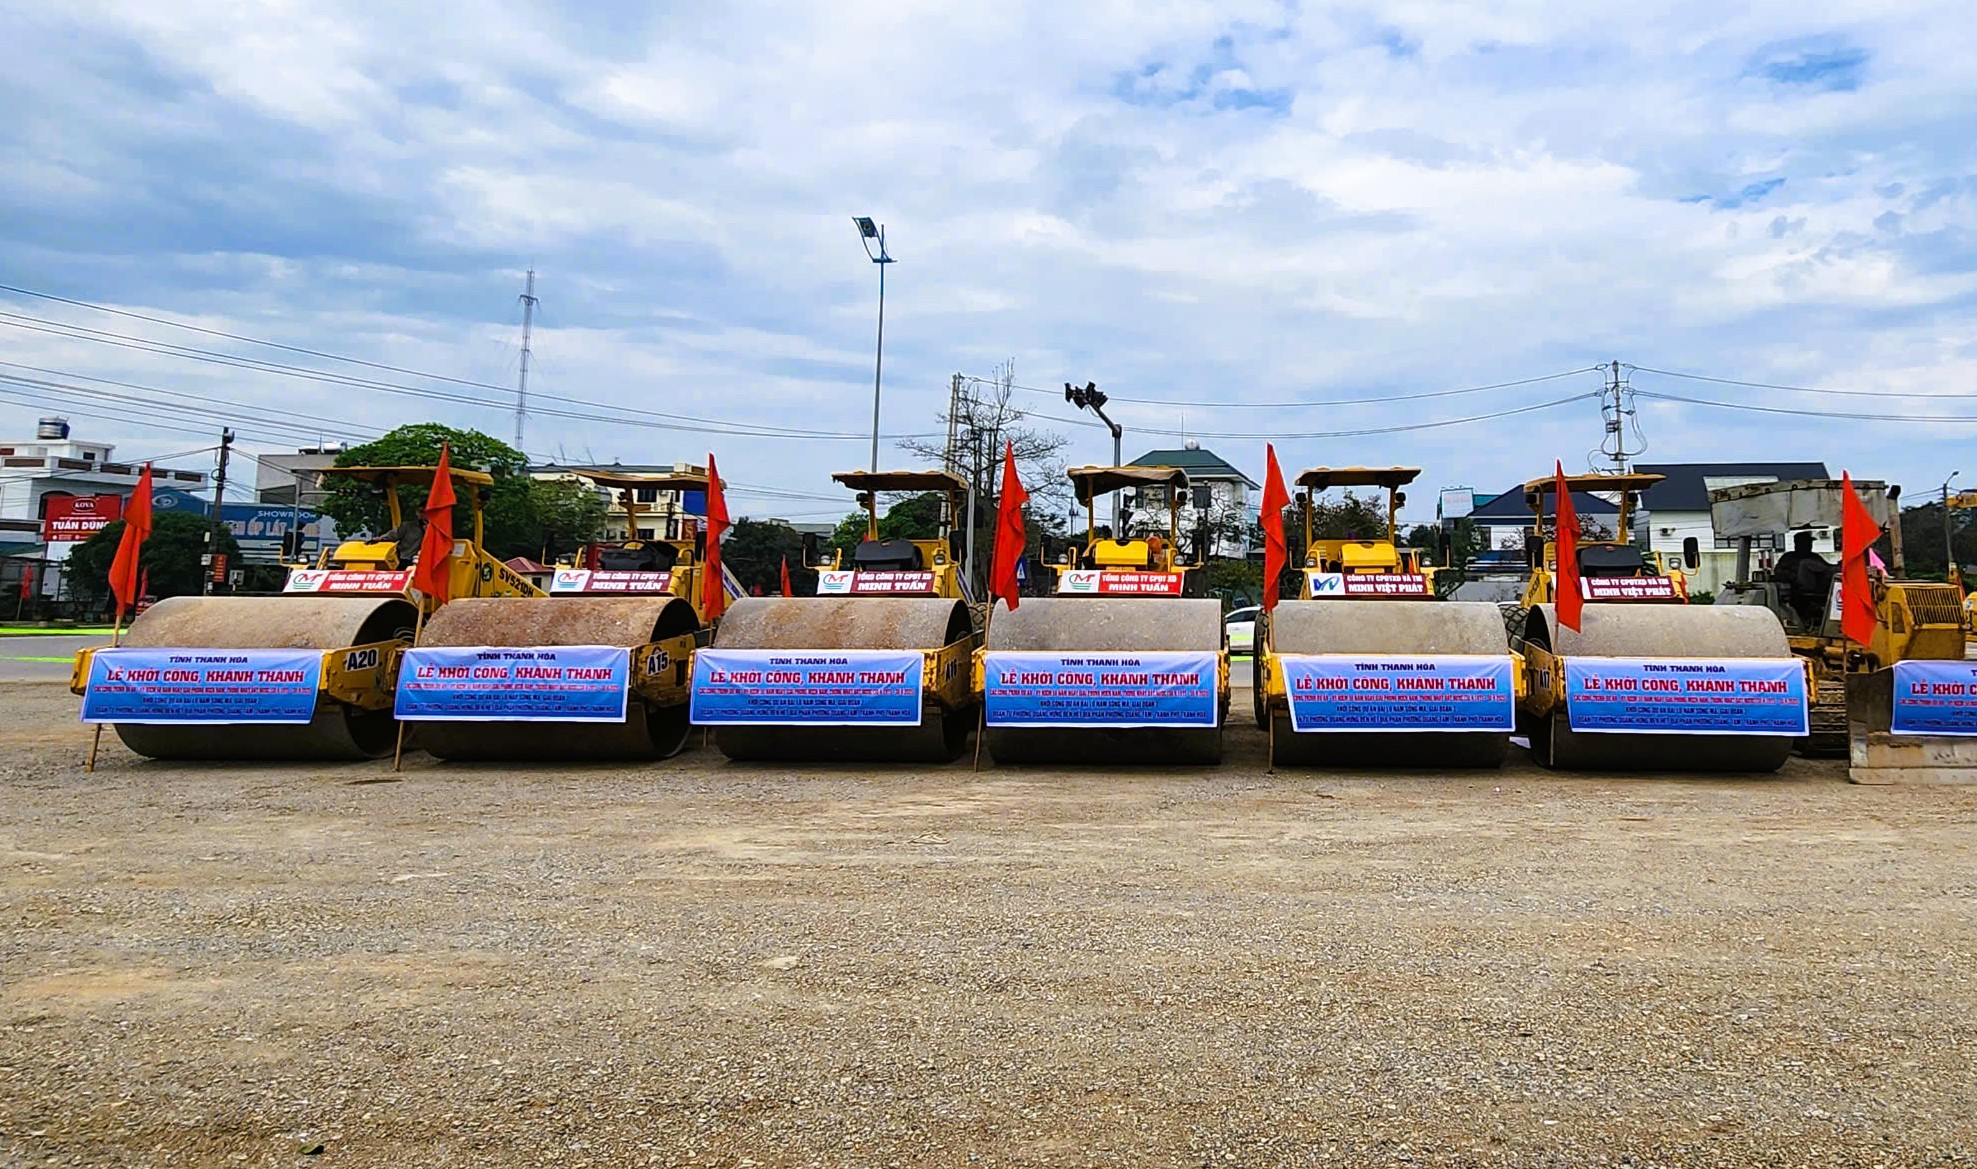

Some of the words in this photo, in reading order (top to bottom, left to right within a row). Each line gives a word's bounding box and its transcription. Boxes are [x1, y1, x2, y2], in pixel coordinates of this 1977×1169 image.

[362, 581, 392, 589] TUẤN
[629, 581, 662, 590] TUẤN
[895, 581, 926, 590] TUẤN
[1141, 582, 1168, 591] TUẤN
[1375, 583, 1397, 593] VIỆT
[1398, 583, 1424, 592] PHÁT
[1620, 587, 1643, 597] VIỆT
[1645, 586, 1671, 596] PHÁT
[347, 649, 377, 671] A20
[648, 651, 668, 674] A15
[127, 668, 158, 682] KHỞI
[164, 668, 202, 683] CÔNG,
[206, 668, 254, 682] KHÁNH
[257, 668, 304, 682] THÀNH
[438, 665, 470, 679] KHỞI
[474, 665, 510, 680] CÔNG,
[515, 665, 562, 679] KHÁNH
[566, 666, 612, 680] THÀNH
[1670, 665, 1703, 673] THANH
[730, 669, 762, 684] KHỞI
[766, 670, 804, 685] CÔNG,
[808, 670, 855, 684] KHÁNH
[859, 670, 905, 684] THÀNH
[1021, 669, 1053, 685] KHỞI
[1057, 671, 1097, 687] CÔNG,
[1100, 671, 1148, 685] KHÁNH
[1153, 671, 1199, 685] THÀNH
[1316, 675, 1348, 690] KHỞI
[1353, 676, 1393, 692] CÔNG,
[1397, 676, 1444, 690] KHÁNH
[1448, 676, 1496, 690] THÀNH
[1605, 675, 1638, 691] KHỞI
[1642, 677, 1683, 693] CÔNG,
[1686, 678, 1735, 692] KHÁNH
[1739, 679, 1787, 693] THÀNH
[1932, 681, 1965, 695] KHỞI
